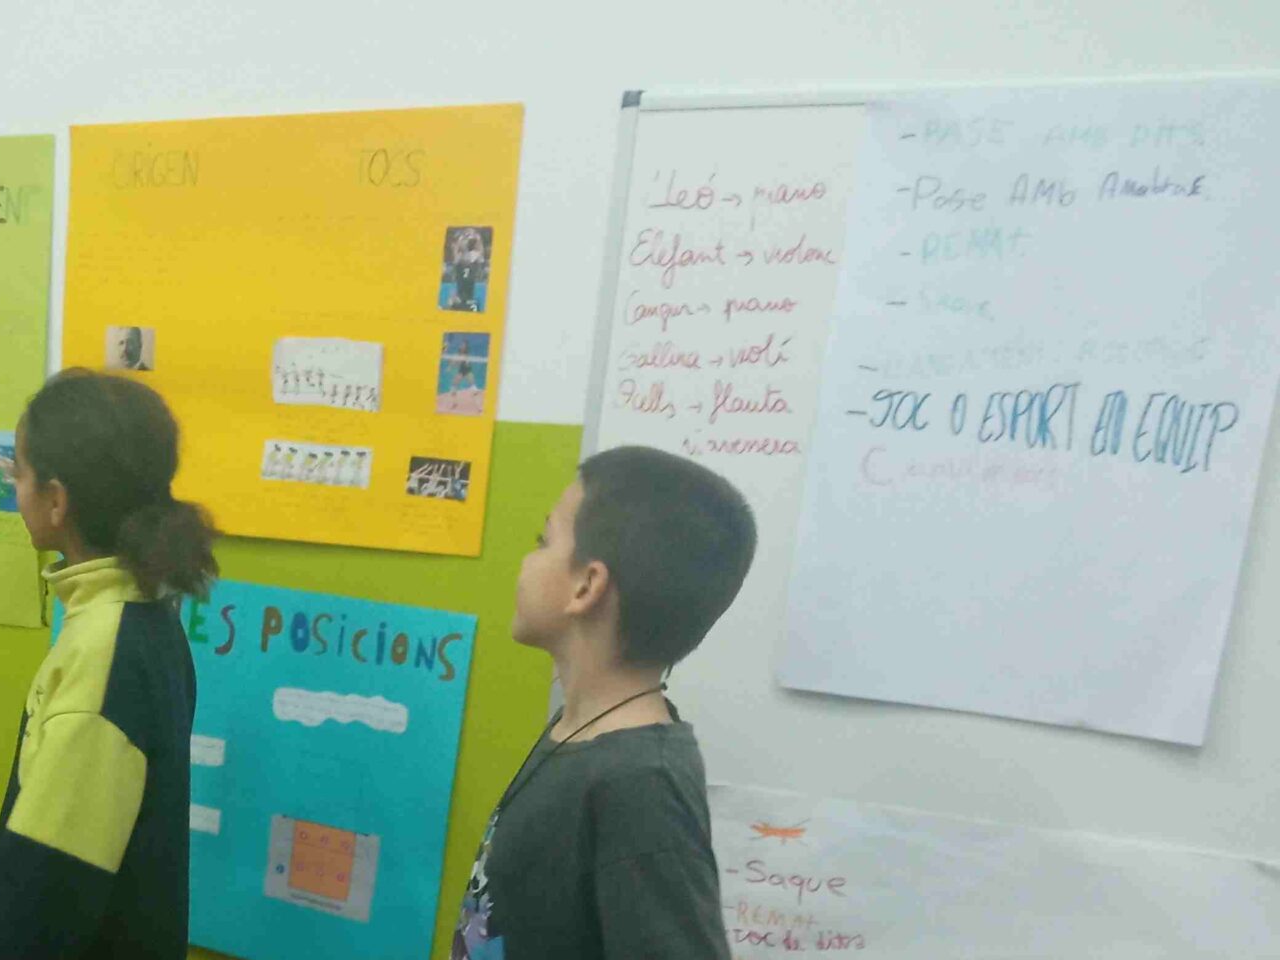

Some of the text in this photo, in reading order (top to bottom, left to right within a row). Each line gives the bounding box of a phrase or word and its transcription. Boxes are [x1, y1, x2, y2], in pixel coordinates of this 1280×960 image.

[629, 228, 725, 289] Elefant
[977, 381, 1083, 452] ESPORT
[1132, 391, 1240, 474] EQUIP
[189, 599, 236, 656] ES
